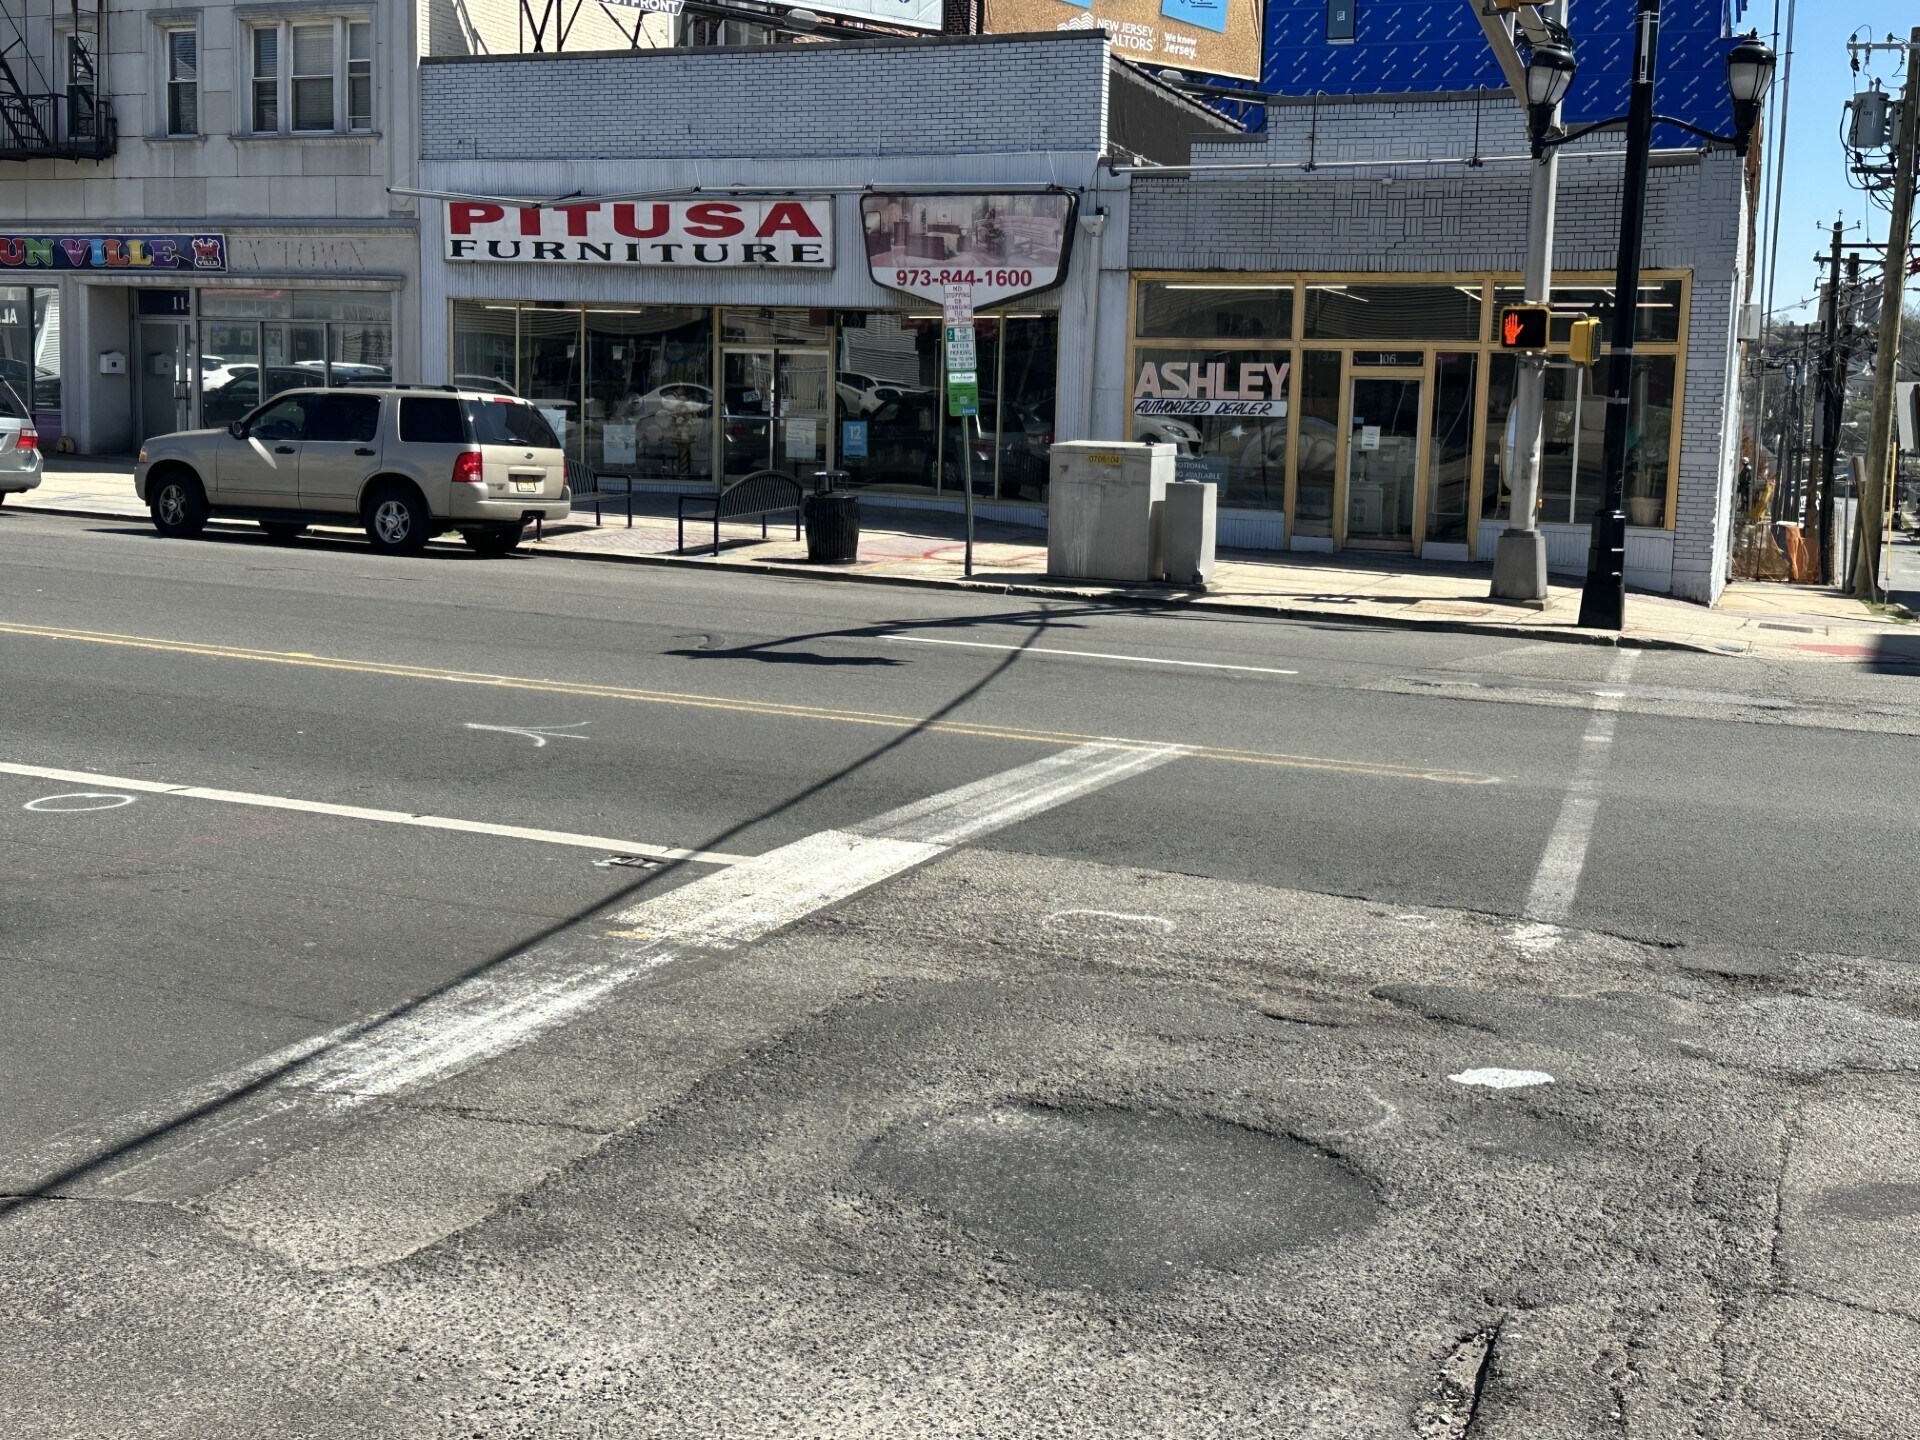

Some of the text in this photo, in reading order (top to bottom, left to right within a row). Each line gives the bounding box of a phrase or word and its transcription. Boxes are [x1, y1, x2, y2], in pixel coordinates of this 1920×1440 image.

[602, 0, 679, 13] FRONT
[1096, 18, 1154, 38] NEW JERSEY
[1164, 31, 1197, 45] We know
[1164, 41, 1197, 60] Jersey.
[449, 202, 823, 239] PITUSA
[0, 238, 180, 268] UN VILLE
[450, 239, 825, 263] FURNITURE
[896, 269, 1032, 287] 973-844-1600
[171, 296, 190, 310] 11
[1379, 353, 1397, 364] 106
[1134, 361, 1291, 401] ASHLEY
[1134, 399, 1273, 416] AUTHORIZED DEALER
[848, 425, 862, 440] 12
